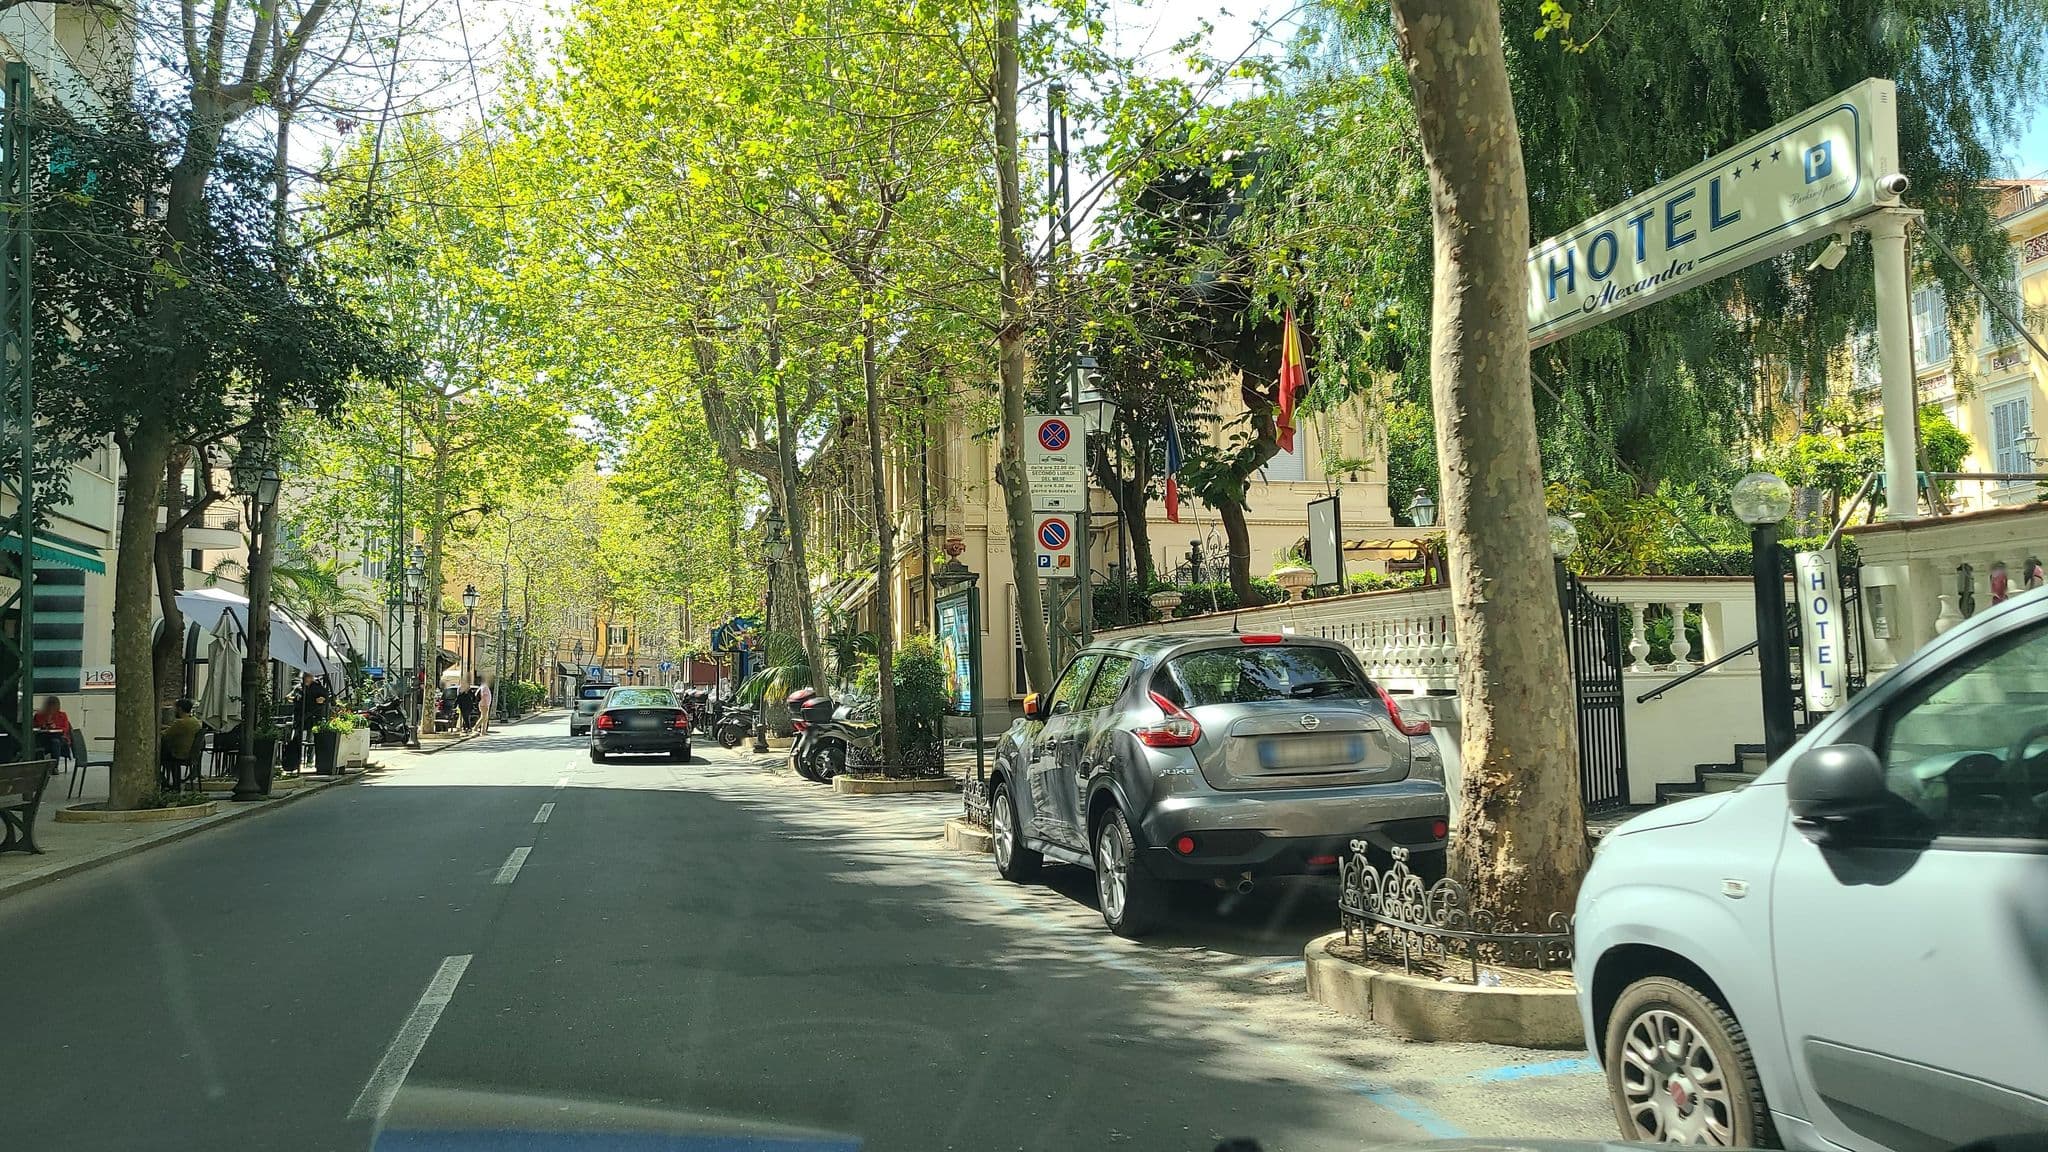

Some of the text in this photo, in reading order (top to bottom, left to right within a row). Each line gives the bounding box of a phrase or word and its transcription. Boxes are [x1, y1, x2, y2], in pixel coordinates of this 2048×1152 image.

[1809, 149, 1826, 178] P
[1548, 175, 1742, 302] HOTEL
[1582, 257, 1696, 314] Alexander
[1040, 557, 1048, 566] P
[1810, 571, 1833, 689] HOTEL
[1158, 768, 1195, 778] JUKE
